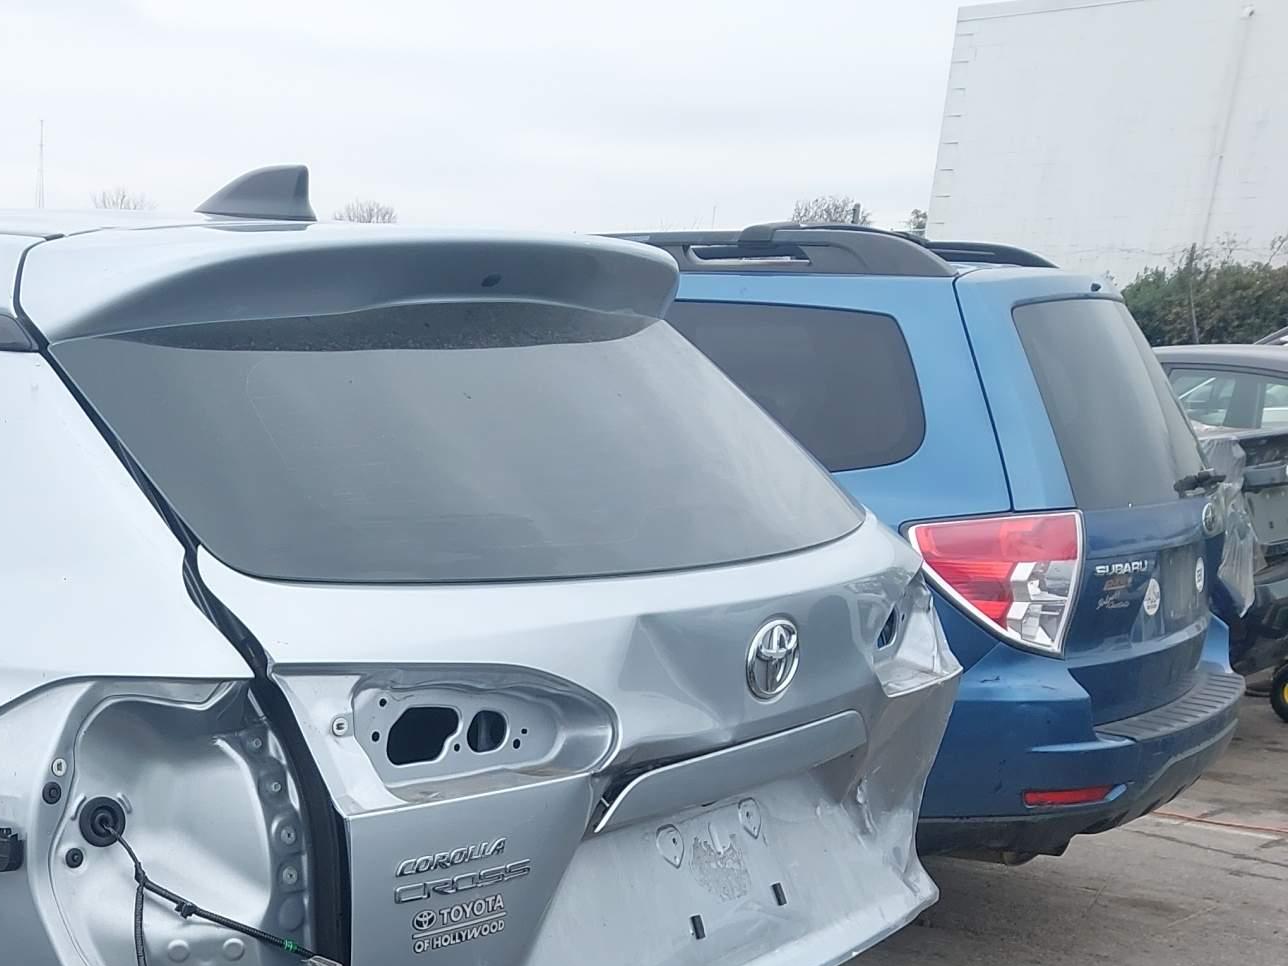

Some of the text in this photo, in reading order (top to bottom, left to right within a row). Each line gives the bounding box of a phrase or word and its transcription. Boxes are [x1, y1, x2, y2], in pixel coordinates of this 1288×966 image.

[1095, 560, 1148, 575] SUBARU
[395, 837, 507, 878] COROLLA
[394, 858, 531, 904] CROSS
[439, 894, 505, 925] TOYOTA
[414, 919, 505, 954] OF HOLLYWOOD
